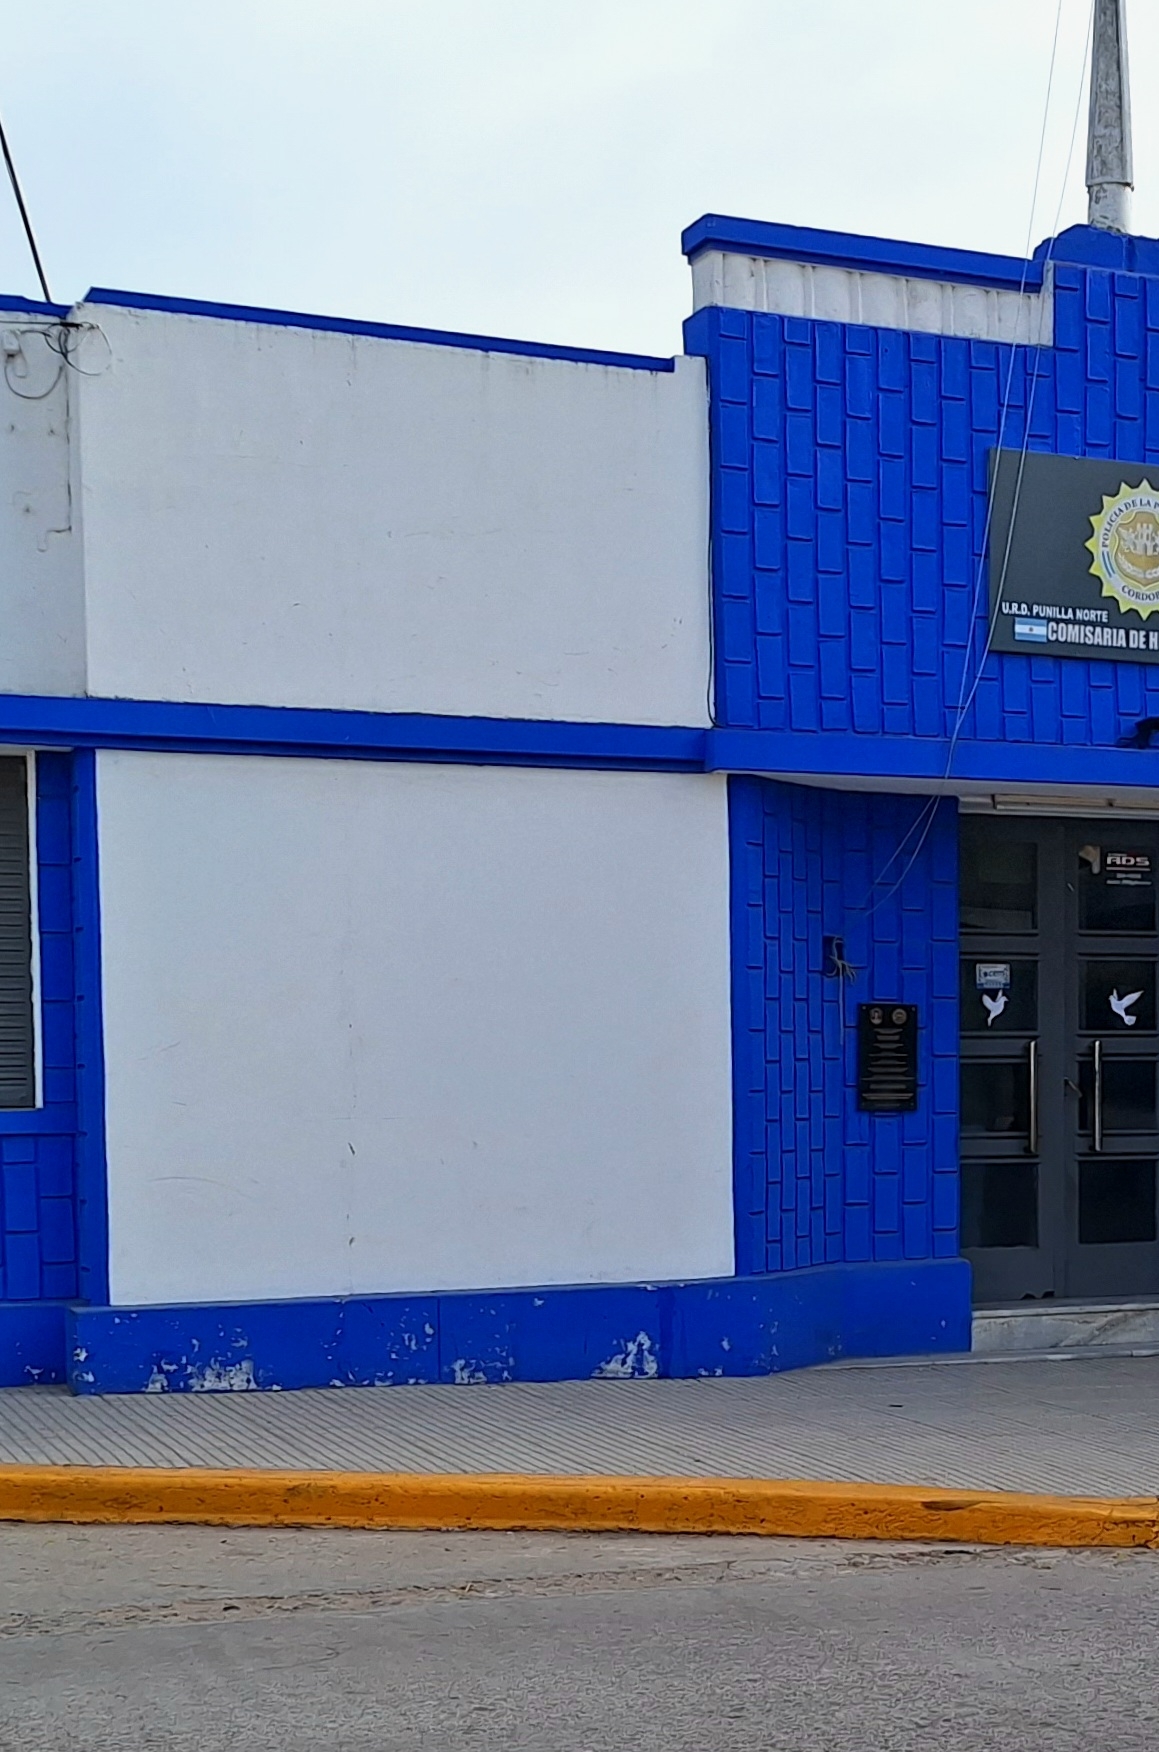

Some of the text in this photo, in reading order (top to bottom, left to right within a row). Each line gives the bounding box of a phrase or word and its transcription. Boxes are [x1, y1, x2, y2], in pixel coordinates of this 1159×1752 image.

[1102, 507, 1125, 548] POLICIA
[1124, 499, 1138, 512] DE
[1139, 498, 1152, 508] LA
[1001, 602, 1109, 622] U.R.D. PUNILLA NORTE
[1047, 622, 1127, 648] COMISARIA
[1128, 629, 1147, 650] DE
